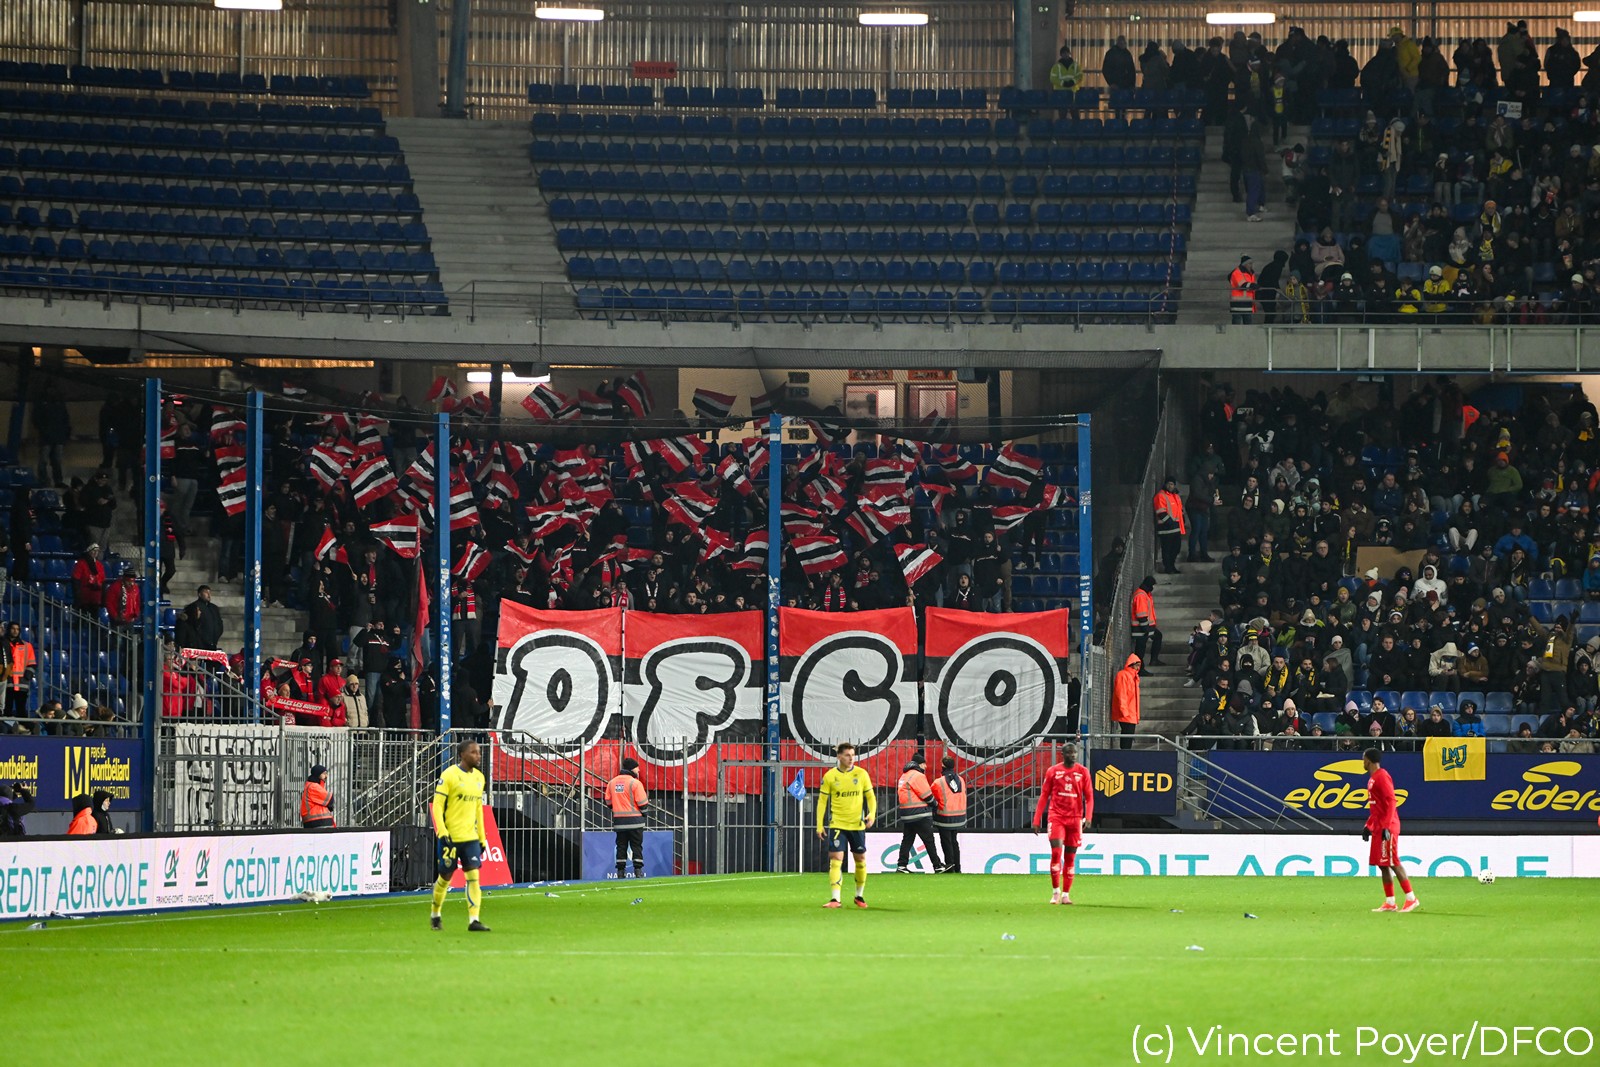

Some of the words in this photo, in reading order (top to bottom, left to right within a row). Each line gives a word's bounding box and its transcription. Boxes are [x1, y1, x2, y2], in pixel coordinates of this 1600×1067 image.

[277, 698, 293, 706] ALLEZ
[502, 628, 1060, 767] DFCO
[0, 755, 38, 779] ontbéliard
[90, 757, 130, 781] Montbéliard
[1129, 771, 1173, 792] TED
[833, 829, 841, 840] 7
[442, 846, 457, 860] 24
[0, 855, 52, 914] RÉDIT
[56, 862, 149, 911] AGRICOLE
[223, 847, 280, 900] CRÉDIT
[283, 853, 359, 894] AGRICOLE
